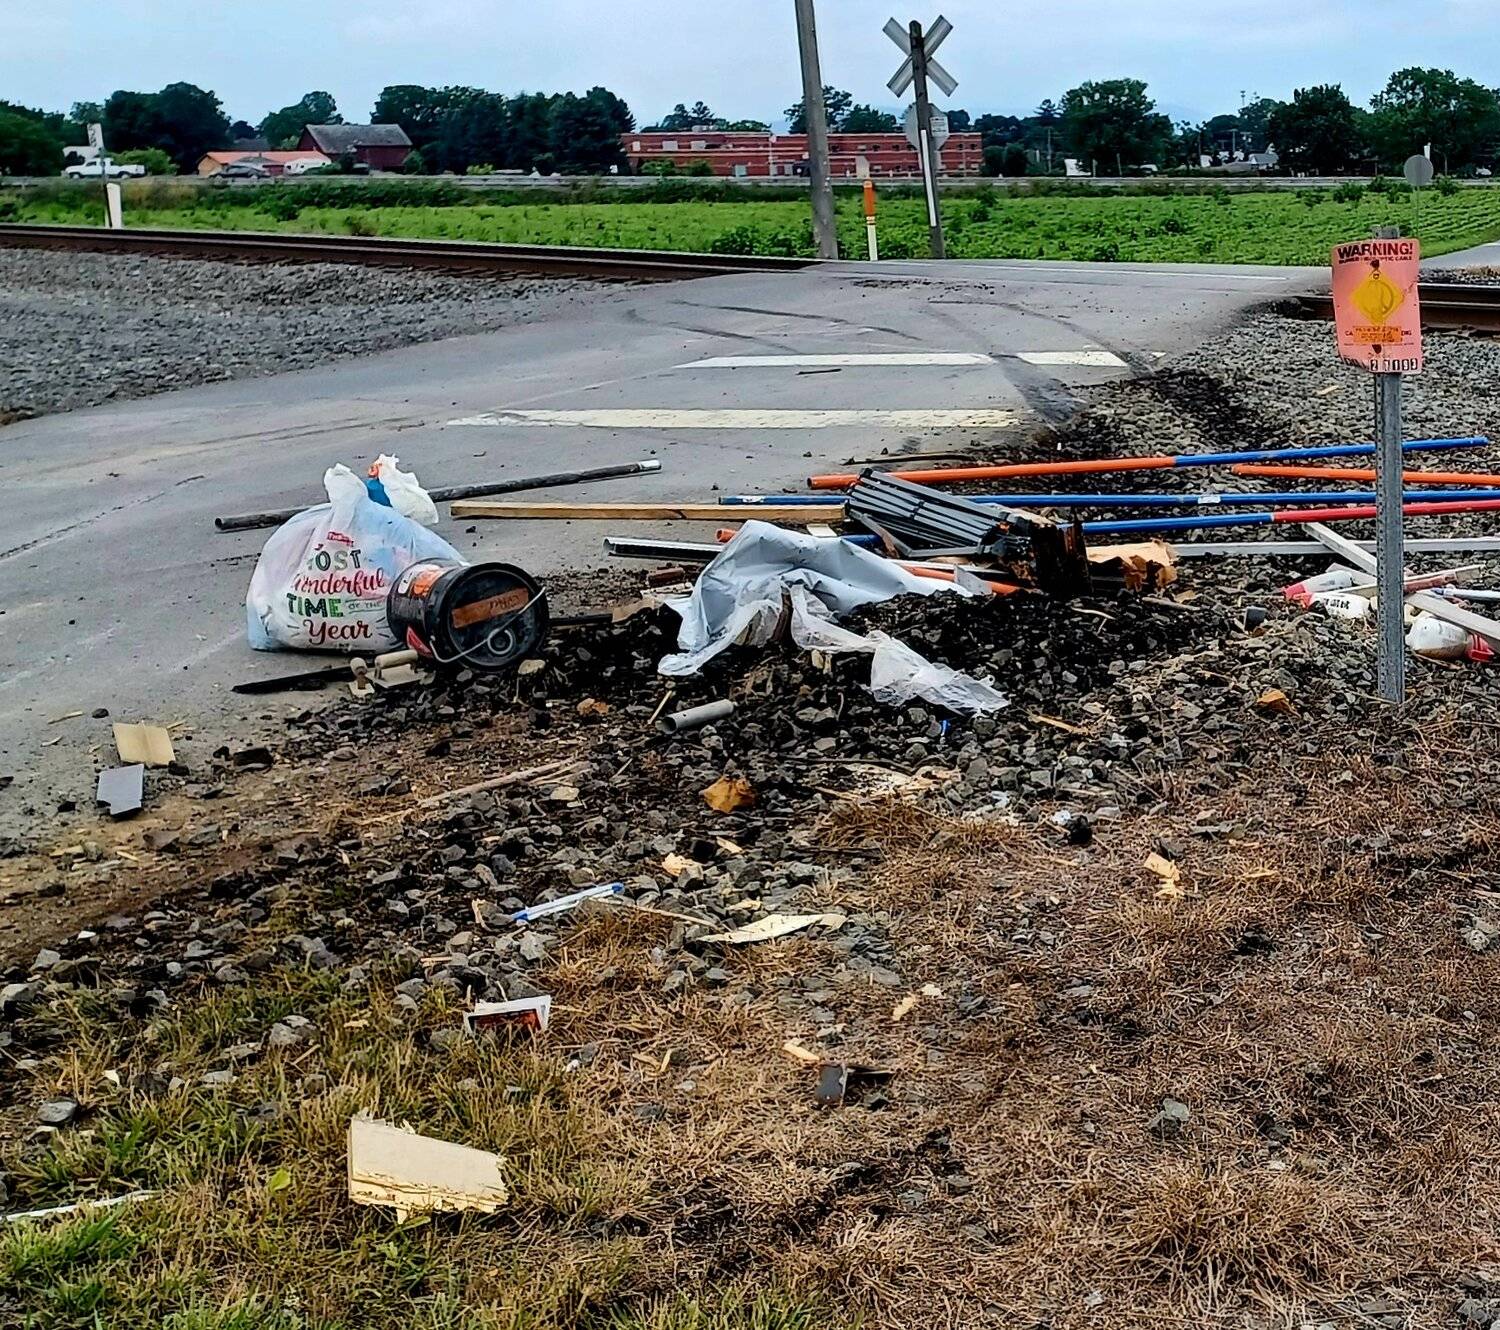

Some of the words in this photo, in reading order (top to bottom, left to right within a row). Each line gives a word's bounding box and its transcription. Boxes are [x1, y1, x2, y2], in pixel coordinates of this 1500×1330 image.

[1337, 243, 1413, 259] WARNING!
[287, 593, 343, 617] TIME
[303, 620, 373, 645] Year
